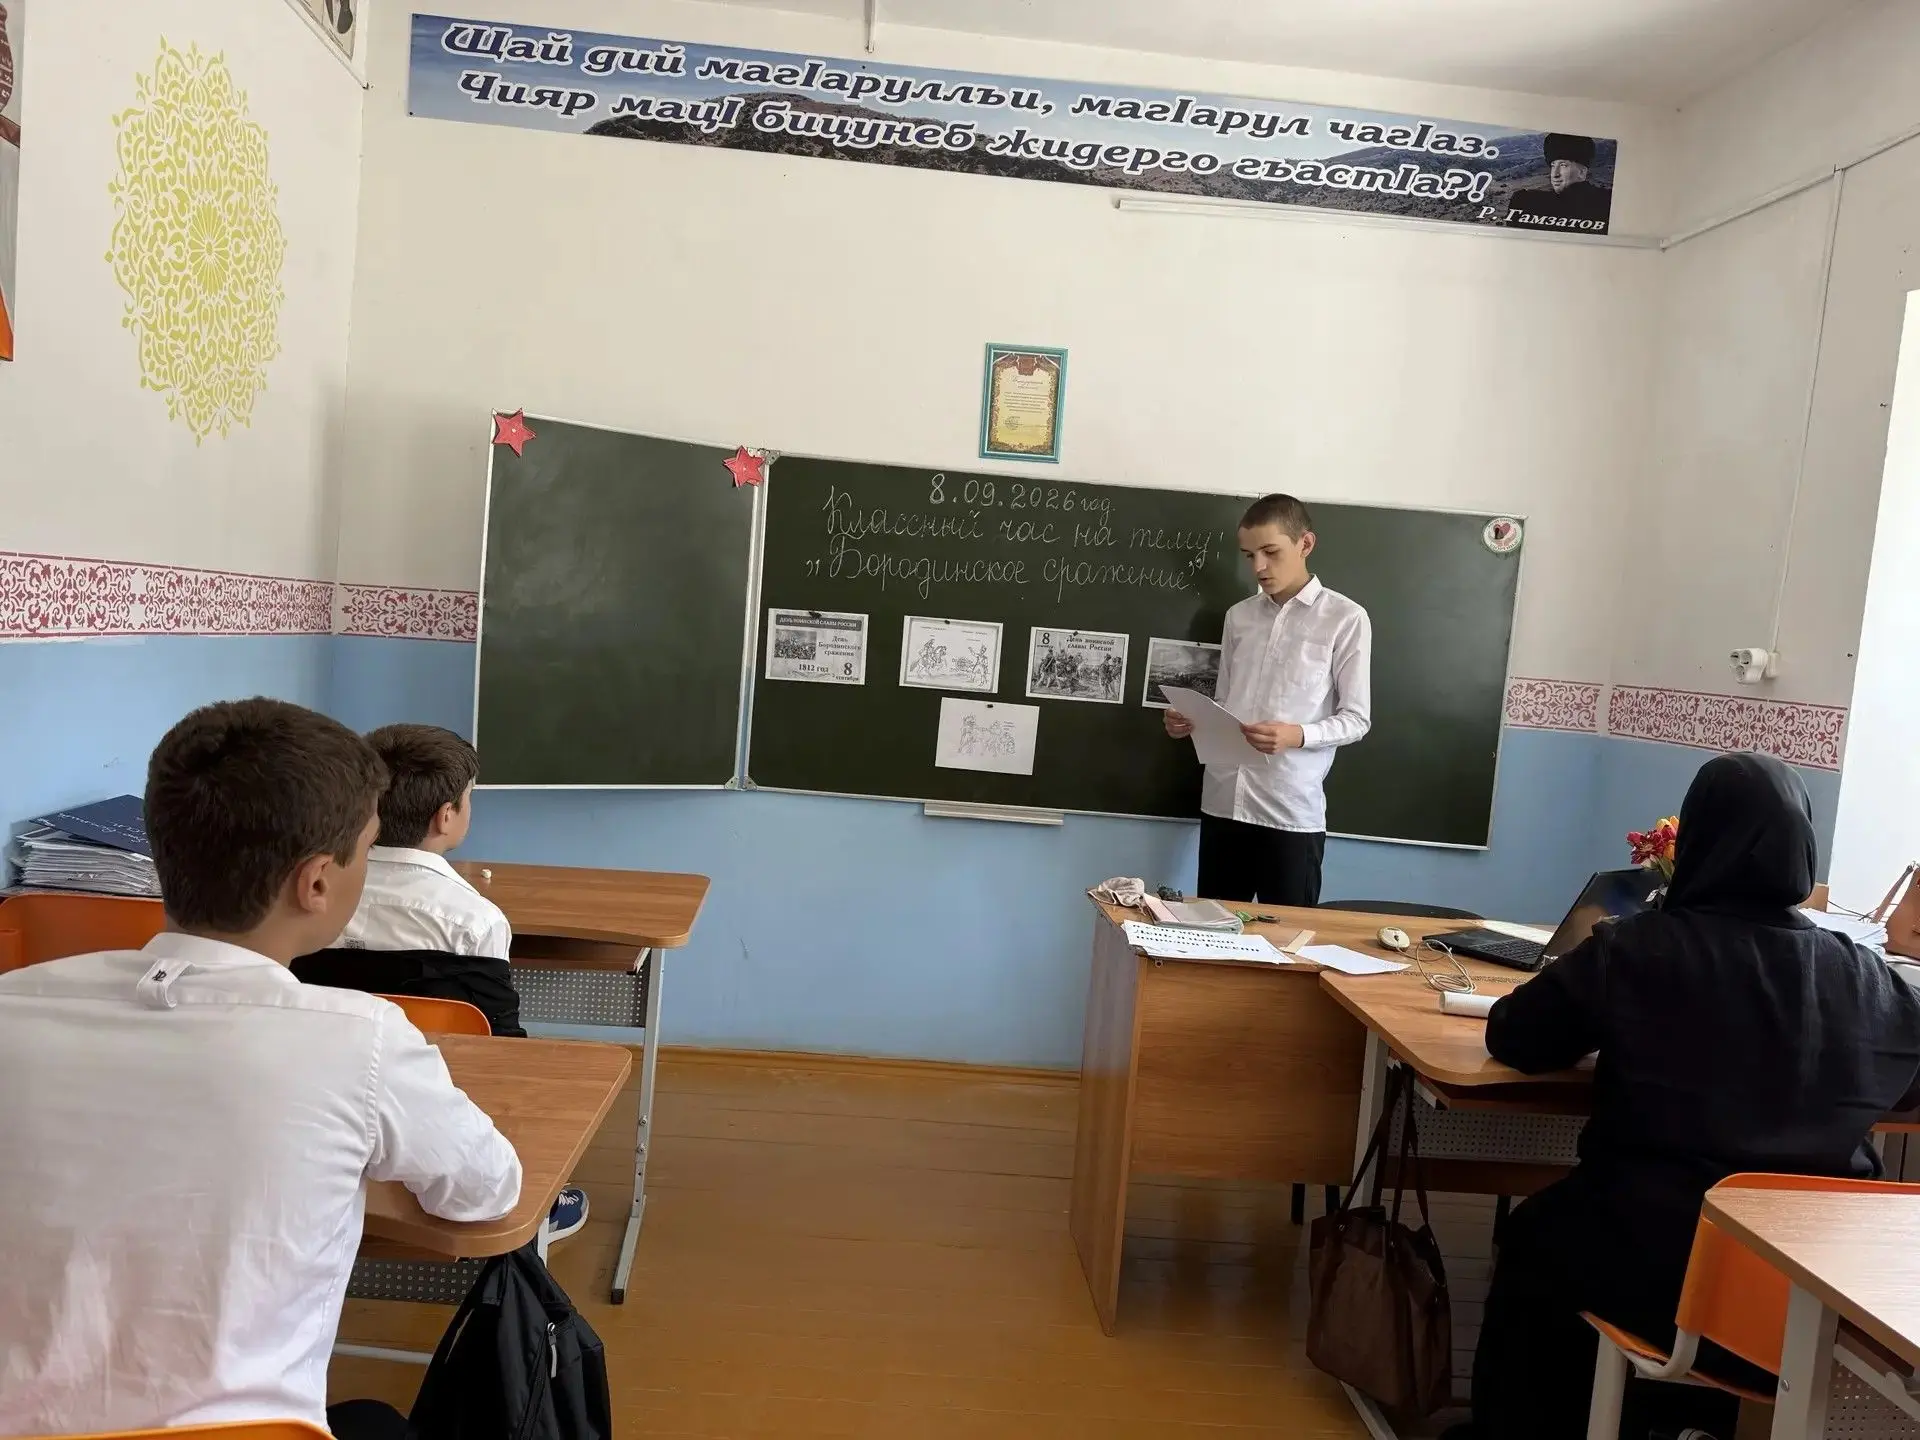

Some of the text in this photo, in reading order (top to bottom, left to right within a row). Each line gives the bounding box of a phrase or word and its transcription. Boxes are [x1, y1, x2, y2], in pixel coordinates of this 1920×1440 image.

[444, 25, 572, 63] Щай
[583, 46, 683, 74] дий
[460, 72, 597, 116] Чияр
[756, 104, 976, 148] бицунеб
[989, 129, 1219, 172] жидерго
[1476, 206, 1605, 231] Р. Гамзатов
[823, 484, 984, 540] Классный
[998, 519, 1061, 543] час
[1073, 523, 1119, 548] на
[831, 635, 848, 643] День
[1042, 632, 1050, 645] 8
[818, 641, 861, 651] Бородинского
[1089, 643, 1113, 652] России
[798, 663, 815, 672] 1812
[843, 662, 853, 676] 8
